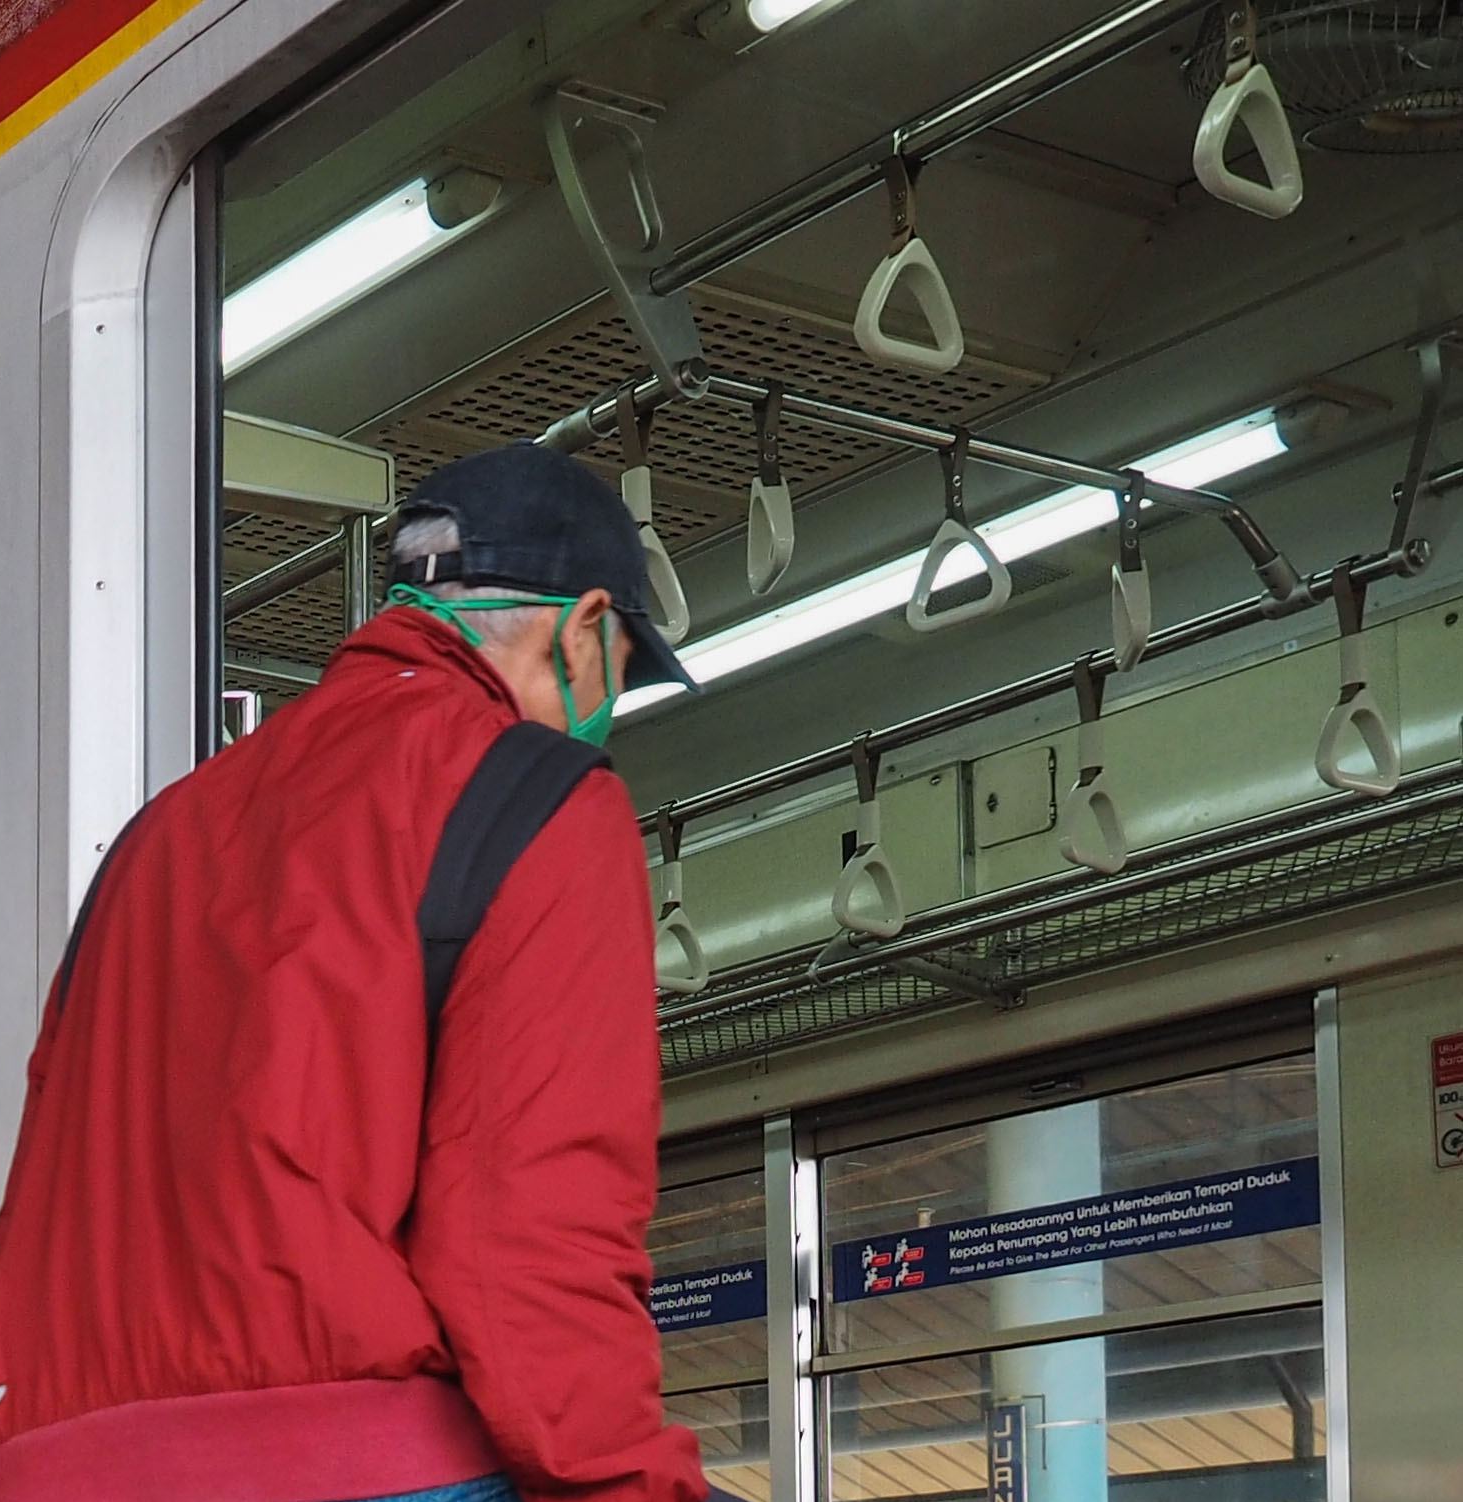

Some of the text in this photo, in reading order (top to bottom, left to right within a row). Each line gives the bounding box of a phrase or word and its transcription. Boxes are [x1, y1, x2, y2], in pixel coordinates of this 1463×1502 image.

[949, 1169, 1291, 1243] Mohon Kesadarannya Untuk Memberikan Tempat Duduk
[949, 1200, 1233, 1261] Kepada Penumpang Yang Lebih Membutuhkan
[949, 1263, 974, 1276] Please
[987, 1258, 1004, 1270] Kind
[1015, 1253, 1034, 1264] Give
[1035, 1250, 1049, 1261] The
[1050, 1247, 1069, 1259] Seat
[1070, 1244, 1083, 1256] For
[1084, 1241, 1107, 1253] Other
[1108, 1233, 1155, 1249] Passengers
[1157, 1229, 1176, 1241] Who
[1178, 1224, 1202, 1237] Need
[1210, 1219, 1233, 1231] Most
[649, 1268, 753, 1297] berikan Tempat Duduk
[650, 1292, 712, 1312] embutuhkan
